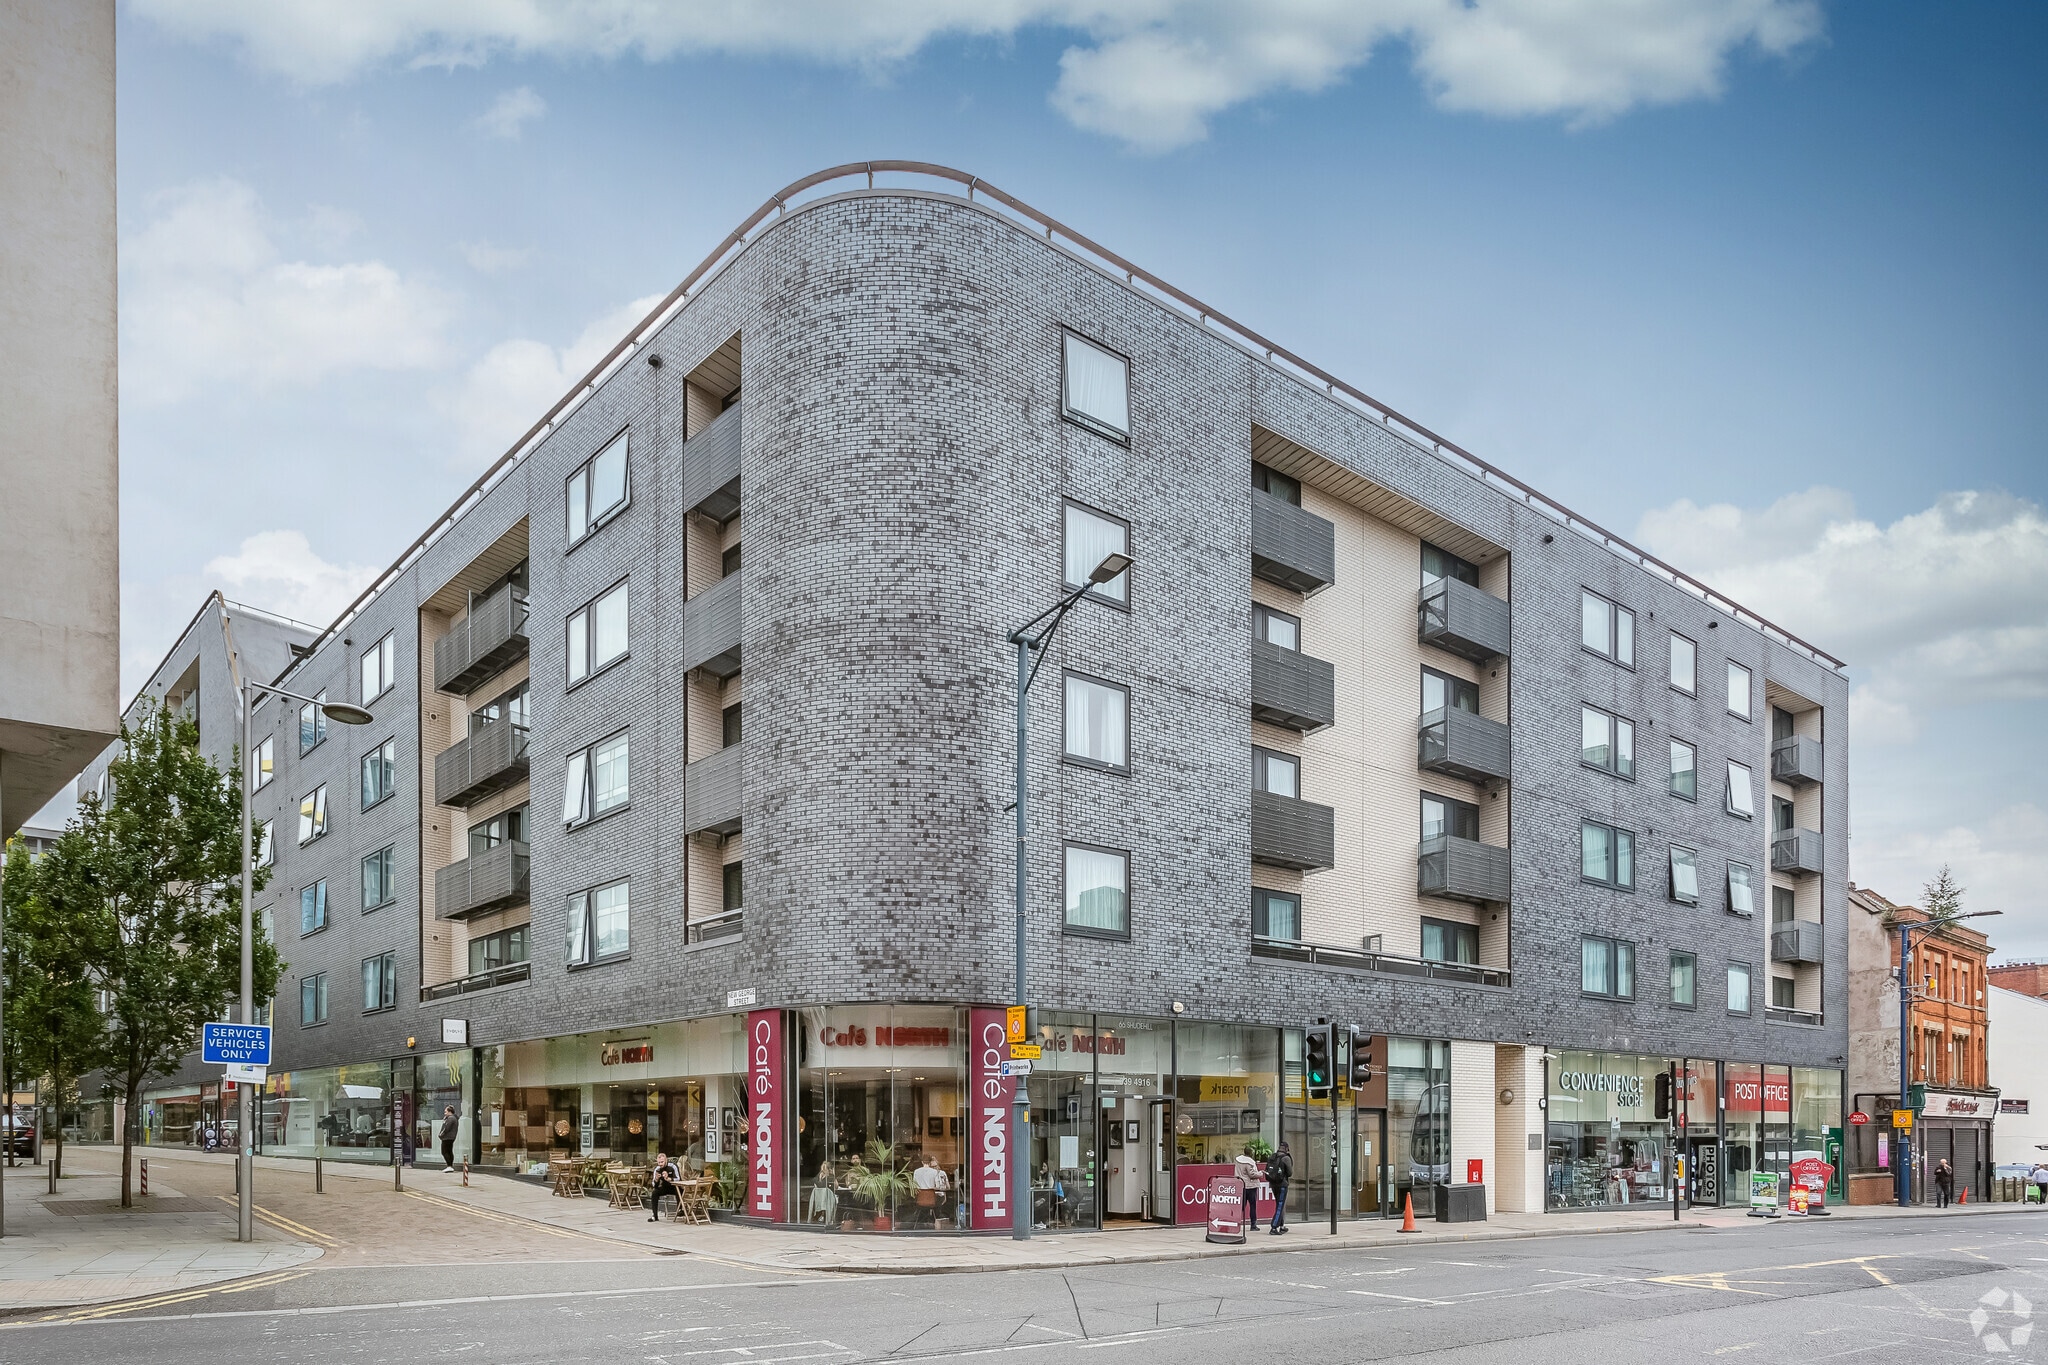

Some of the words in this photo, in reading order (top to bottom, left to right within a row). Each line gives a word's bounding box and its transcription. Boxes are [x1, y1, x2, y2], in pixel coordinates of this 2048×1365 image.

[212, 1028, 262, 1039] SERVICE
[820, 1024, 867, 1047] Café
[875, 1026, 949, 1046] NORTH
[209, 1038, 266, 1050] VEHICLES
[1072, 1034, 1126, 1056] NORTH
[221, 1049, 252, 1059] ONLY
[601, 1049, 620, 1066] Café
[755, 1019, 773, 1095] Café
[983, 1022, 1007, 1099] Café
[1133, 1078, 1151, 1087] 4916
[1560, 1071, 1644, 1093] CONVENIENCE
[1618, 1093, 1644, 1107] STORE
[1735, 1083, 1758, 1100] POST
[756, 1103, 772, 1211] NORTH
[983, 1107, 1006, 1217] NORTH
[1706, 1146, 1716, 1197] PHOTOS
[1218, 1185, 1236, 1194] Café
[1211, 1194, 1241, 1205] NORTH
